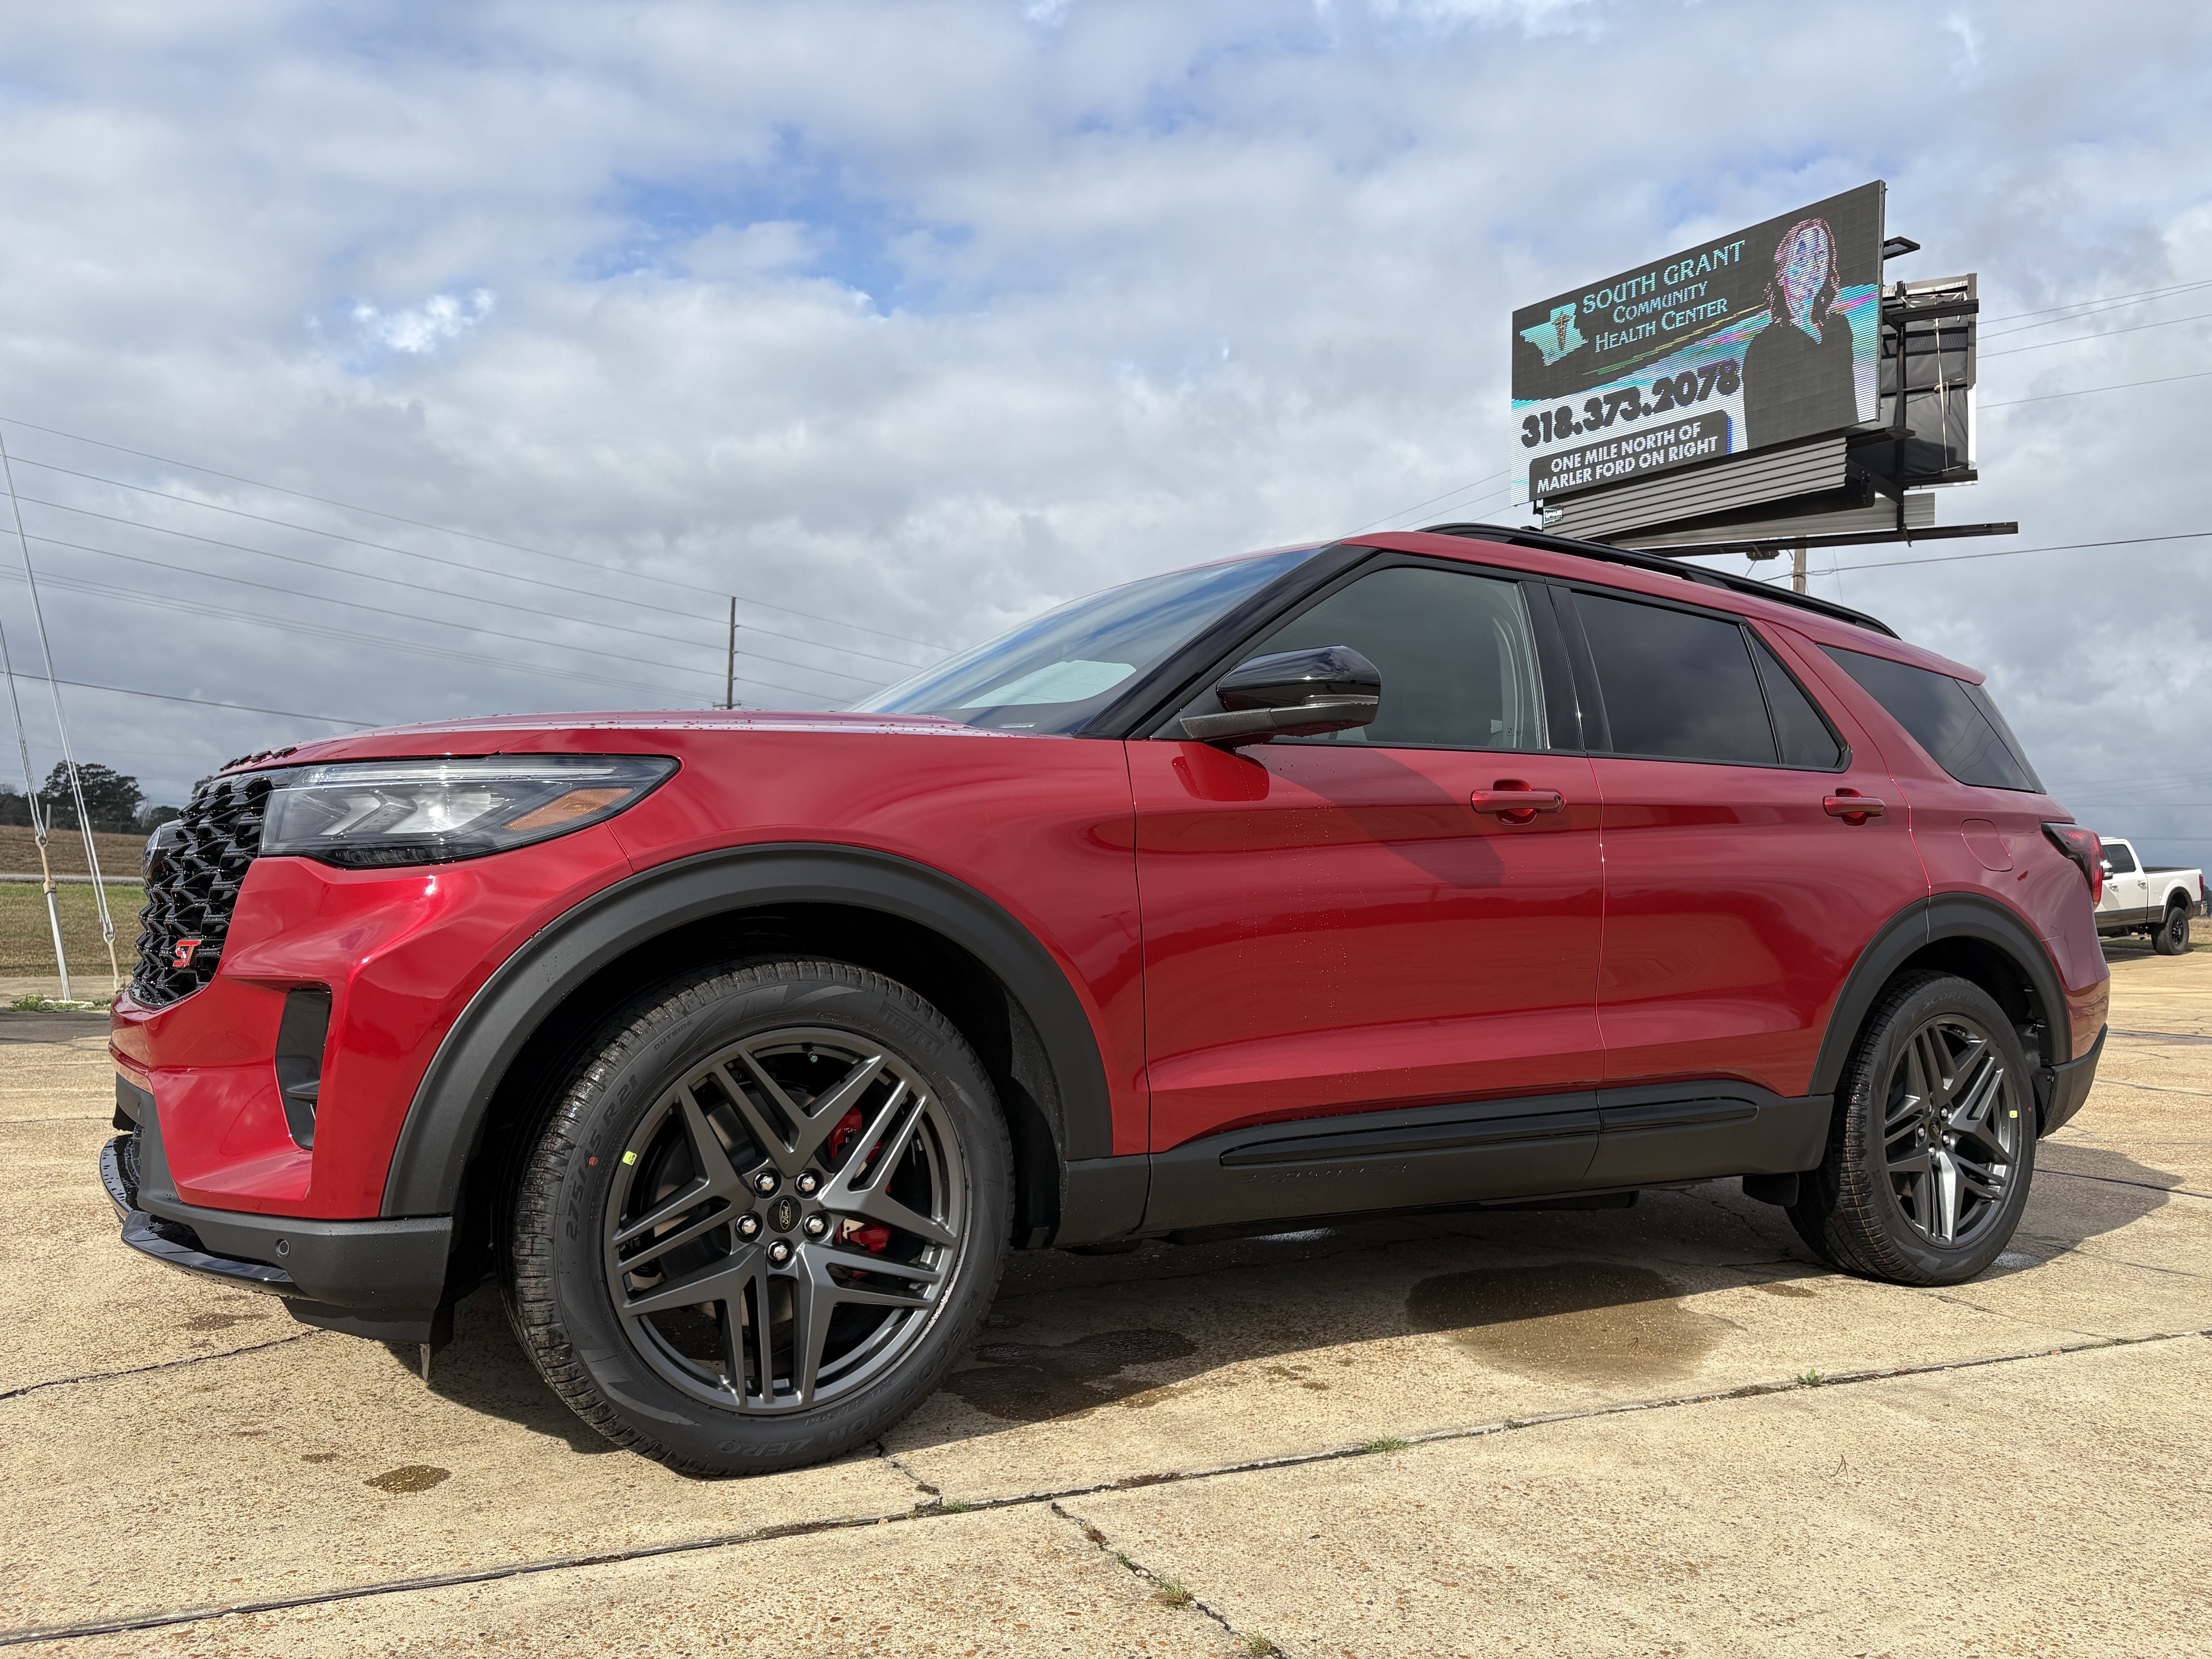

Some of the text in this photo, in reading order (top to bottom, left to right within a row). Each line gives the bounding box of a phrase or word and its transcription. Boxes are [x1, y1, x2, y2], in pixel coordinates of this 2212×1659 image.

[1583, 240, 1745, 314] SOUTH GRANT
[1613, 281, 1708, 323] COMMUNITY
[1595, 298, 1728, 353] HEALTH CENTER
[1521, 359, 1742, 448] 318.373.2078
[1537, 436, 1718, 494] MARLER FORD ON RIGHT
[1551, 422, 1701, 473] ONE MILE NORTH OF
[172, 939, 202, 967] ST
[654, 1019, 694, 1050] OUTSIDE
[566, 1128, 603, 1242] 275/45
[713, 1319, 962, 1457] SCORPION ZERO
